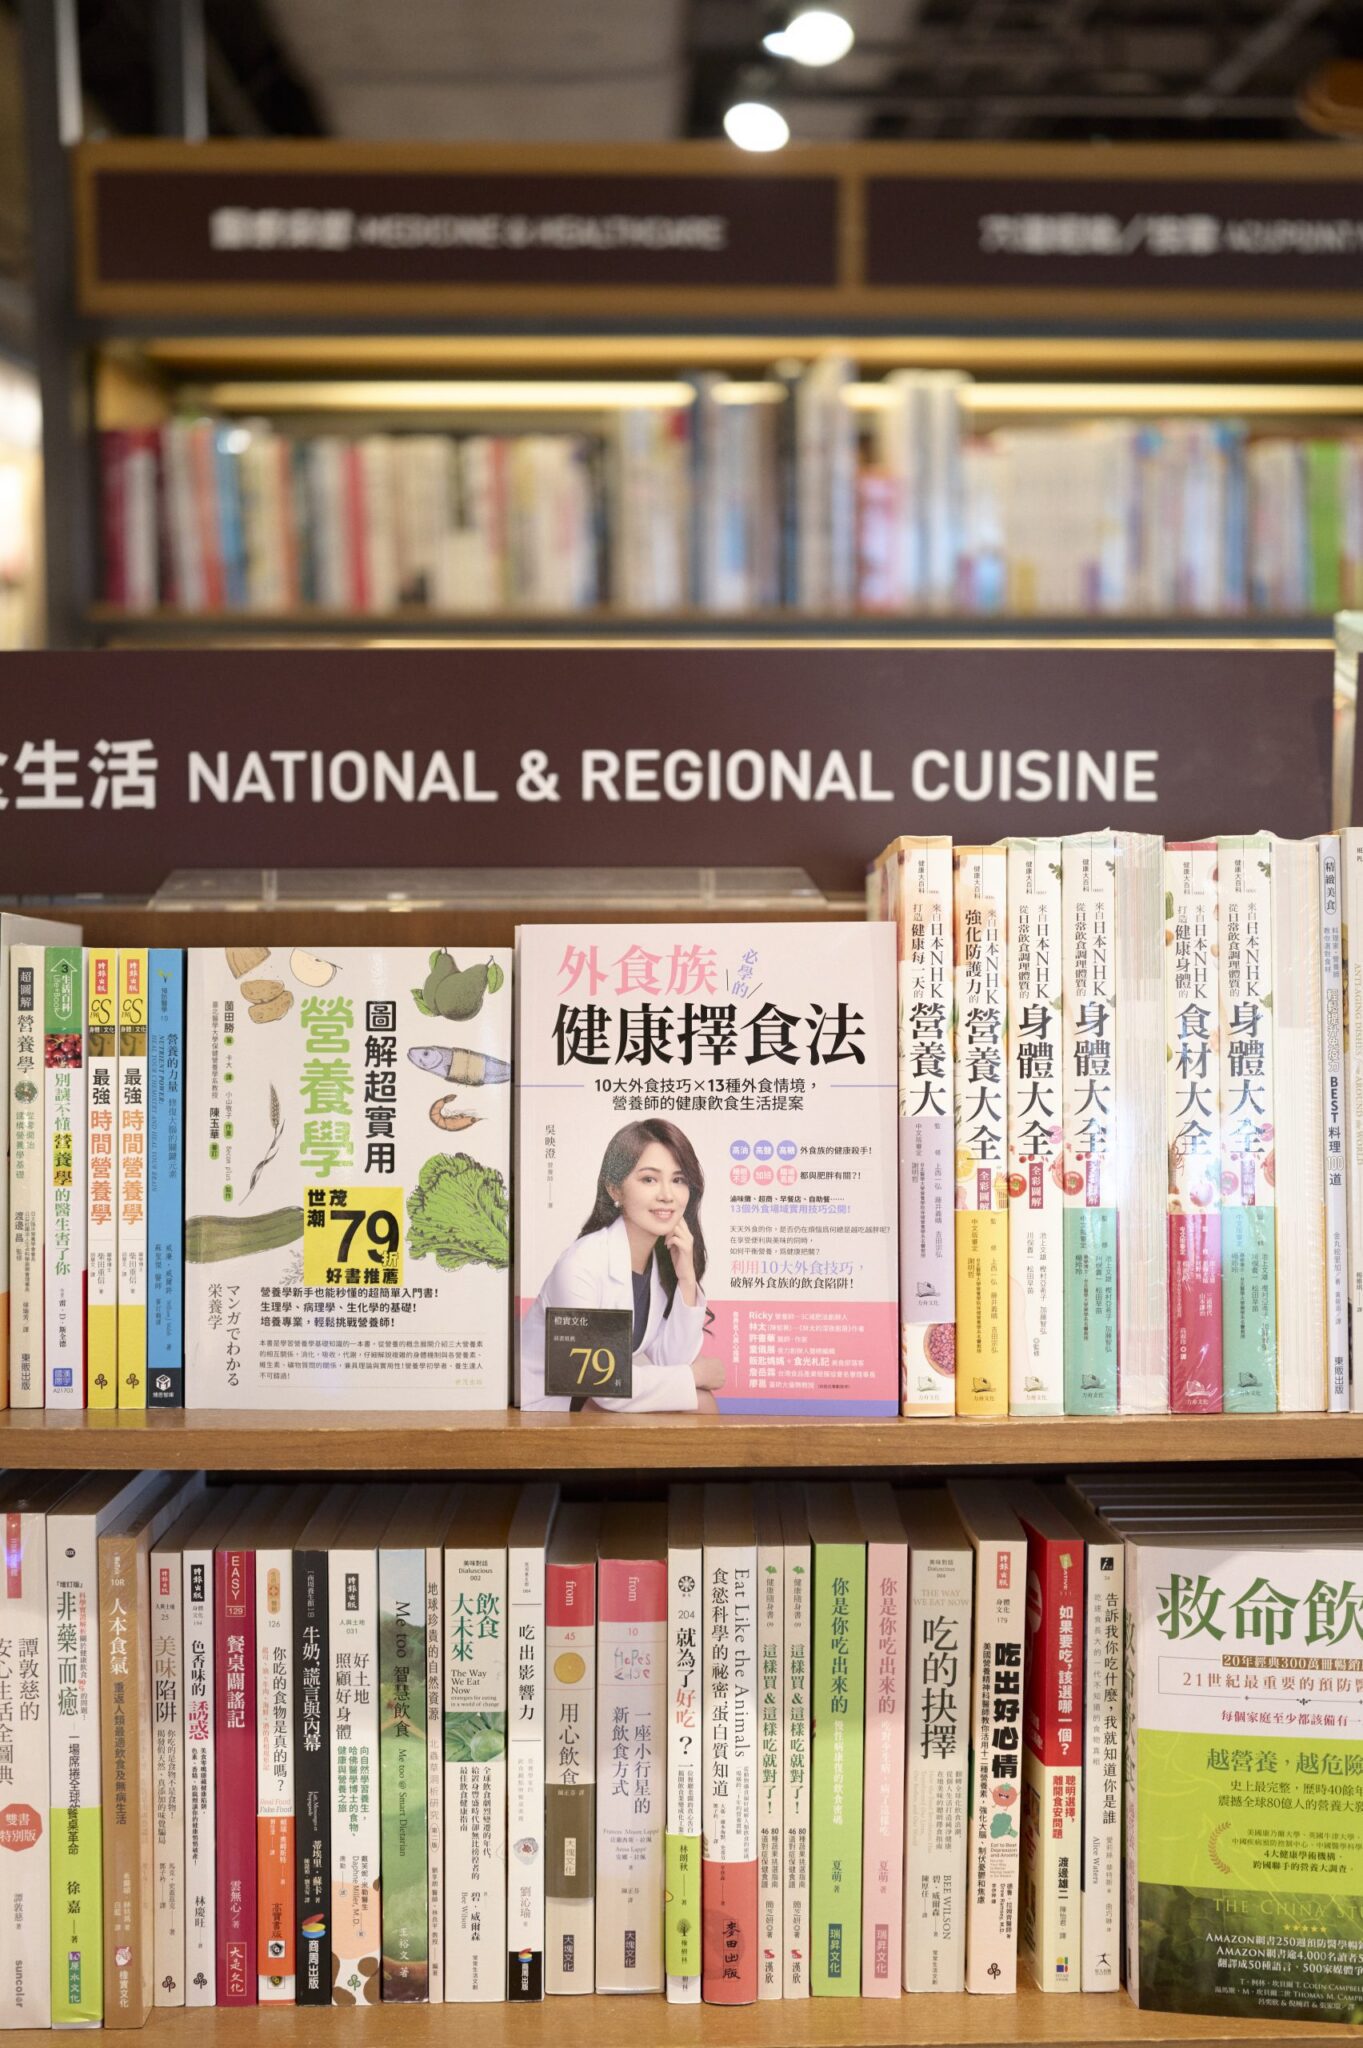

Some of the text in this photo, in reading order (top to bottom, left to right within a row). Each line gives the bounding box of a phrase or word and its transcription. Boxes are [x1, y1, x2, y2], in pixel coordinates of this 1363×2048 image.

[0, 739, 1158, 809] 生活 NATIONAL & REGIONAL CUISINE
[62, 964, 68, 972] 3
[557, 944, 718, 997] 外食族
[732, 948, 759, 999] 必學的
[912, 904, 925, 998] 打造健康每一天的
[931, 904, 943, 998] 來自日本NHK
[966, 911, 981, 1003] 強化防護力的
[986, 909, 999, 1004] 來自日本NHK
[1018, 905, 1030, 998] 從日常飲食調理體質的
[1036, 904, 1049, 998] 來自日本NHK
[1075, 903, 1087, 997] 從日常飲食調理體質的
[1093, 903, 1107, 997] 來自日本NHK
[1175, 906, 1190, 998] 打造健康身體的
[1194, 906, 1207, 999] 來自日本NHK
[1228, 904, 1240, 997] 從日常飲食調理體質的
[1247, 903, 1259, 997] 來自日本NHK
[17, 971, 34, 1073] 超圖解 營養學
[62, 976, 70, 1011] 生活百科
[168, 1034, 178, 1092] 營養的力量
[552, 1002, 866, 1066] 健康擇食法
[909, 1002, 947, 1117] 營養大
[300, 996, 354, 1178] 營養學
[364, 1000, 397, 1173] 圖解超實用
[613, 1095, 804, 1112] 營養師的健康飲食生活提案
[965, 1008, 1002, 1160] 營養大全
[1016, 1004, 1054, 1156] 身體大全
[1074, 1001, 1111, 1154] 身體大全
[1176, 1003, 1212, 1156] 食材大全
[1227, 1001, 1265, 1153] 身體大全
[54, 1073, 70, 1276] 別讓不懂營養學的醫生害了你
[91, 1068, 112, 1225] 最強時間營養學
[122, 1068, 144, 1225] 最強時間營養學
[800, 1146, 872, 1156] 外食族的健康殺手!
[308, 1190, 347, 1206] 世茂
[1031, 1166, 1041, 1207] 全彩圖解
[307, 1210, 399, 1267] 潮 79 折
[731, 1260, 864, 1275] 利用10大外食技巧，
[208, 1284, 222, 1329] 栄養学
[260, 1287, 438, 1298] 營養學新手也能秒懂的超簡單入門書!
[260, 1302, 416, 1313] 生理學、病理學、生化學的基礎!
[326, 1268, 398, 1284] 好書推薦
[730, 1277, 854, 1289] 破解外食族的飲食陷阱!
[226, 1285, 241, 1386] マンガでわかる
[260, 1317, 395, 1328] 培養專業，輕鬆挑戰營養師!
[554, 1316, 588, 1327] 橙實文化
[749, 1312, 773, 1321] Ricky
[21, 1354, 30, 1390] 東販出版
[570, 1348, 616, 1386] 79
[1335, 1357, 1343, 1394] 東販出版
[111, 1578, 125, 1586] 10R
[231, 1556, 240, 1599] EASY
[566, 1580, 576, 1606] from
[629, 1576, 639, 1601] from
[1156, 1574, 1363, 1646] 救命飲
[109, 1598, 128, 1675] 人本食氣
[451, 1593, 473, 1661] 大未來
[477, 1593, 499, 1638] 飲食
[678, 1610, 695, 1619] 204
[831, 1578, 849, 1714] 你是你吃出來的
[879, 1578, 897, 1714] 你是你吃出來的
[19, 1638, 40, 1721] 譚敦慈的
[57, 1592, 78, 1716] 非藥而癒
[155, 1636, 176, 1722] 美味陷阱
[354, 1653, 370, 1704] 好土地
[394, 1601, 411, 1737] Me too 智慧飲食
[428, 1582, 439, 1721] 地球珍貴的自然資源
[451, 1669, 486, 1678] The Way
[519, 1625, 534, 1720] 吃出影響力
[735, 1569, 750, 1758] Eat Like the Animals
[1224, 1656, 1363, 1671] 20年經典300萬冊暢銷
[189, 1640, 209, 1740] 色香味的誘惑
[336, 1653, 351, 1739] 照顧好身體
[676, 1628, 696, 1755] 就為了好吃？
[921, 1616, 959, 1759] 吃的抉擇
[992, 1643, 1021, 1778] 吃出好心情
[559, 1703, 579, 1784] 用心飲食
[612, 1707, 629, 1796] 新飲食方式
[635, 1712, 651, 1814] 一座小行星的
[1207, 1748, 1363, 1776] 越營養，越危險
[338, 1747, 347, 1812] 健康與營養之旅
[6, 1814, 30, 1826] 雙書
[1058, 1858, 1068, 1899] 渡邊雄二
[1214, 1899, 1249, 1914] THE
[1261, 1901, 1325, 1917] CHINA
[625, 1932, 635, 1967] 大塊文化
[723, 1921, 741, 1979] 麥田出版
[943, 1895, 951, 1940] WILSON
[230, 1948, 243, 1993] 大是文化
[309, 1941, 319, 1989] 商周出版
[563, 1936, 574, 1971] 大塊文化
[765, 1962, 773, 1983] 漢欣
[792, 1962, 801, 1983] 漢欣
[830, 1929, 840, 1973] 瑞昇文化
[877, 1929, 887, 1973] 瑞昇文化
